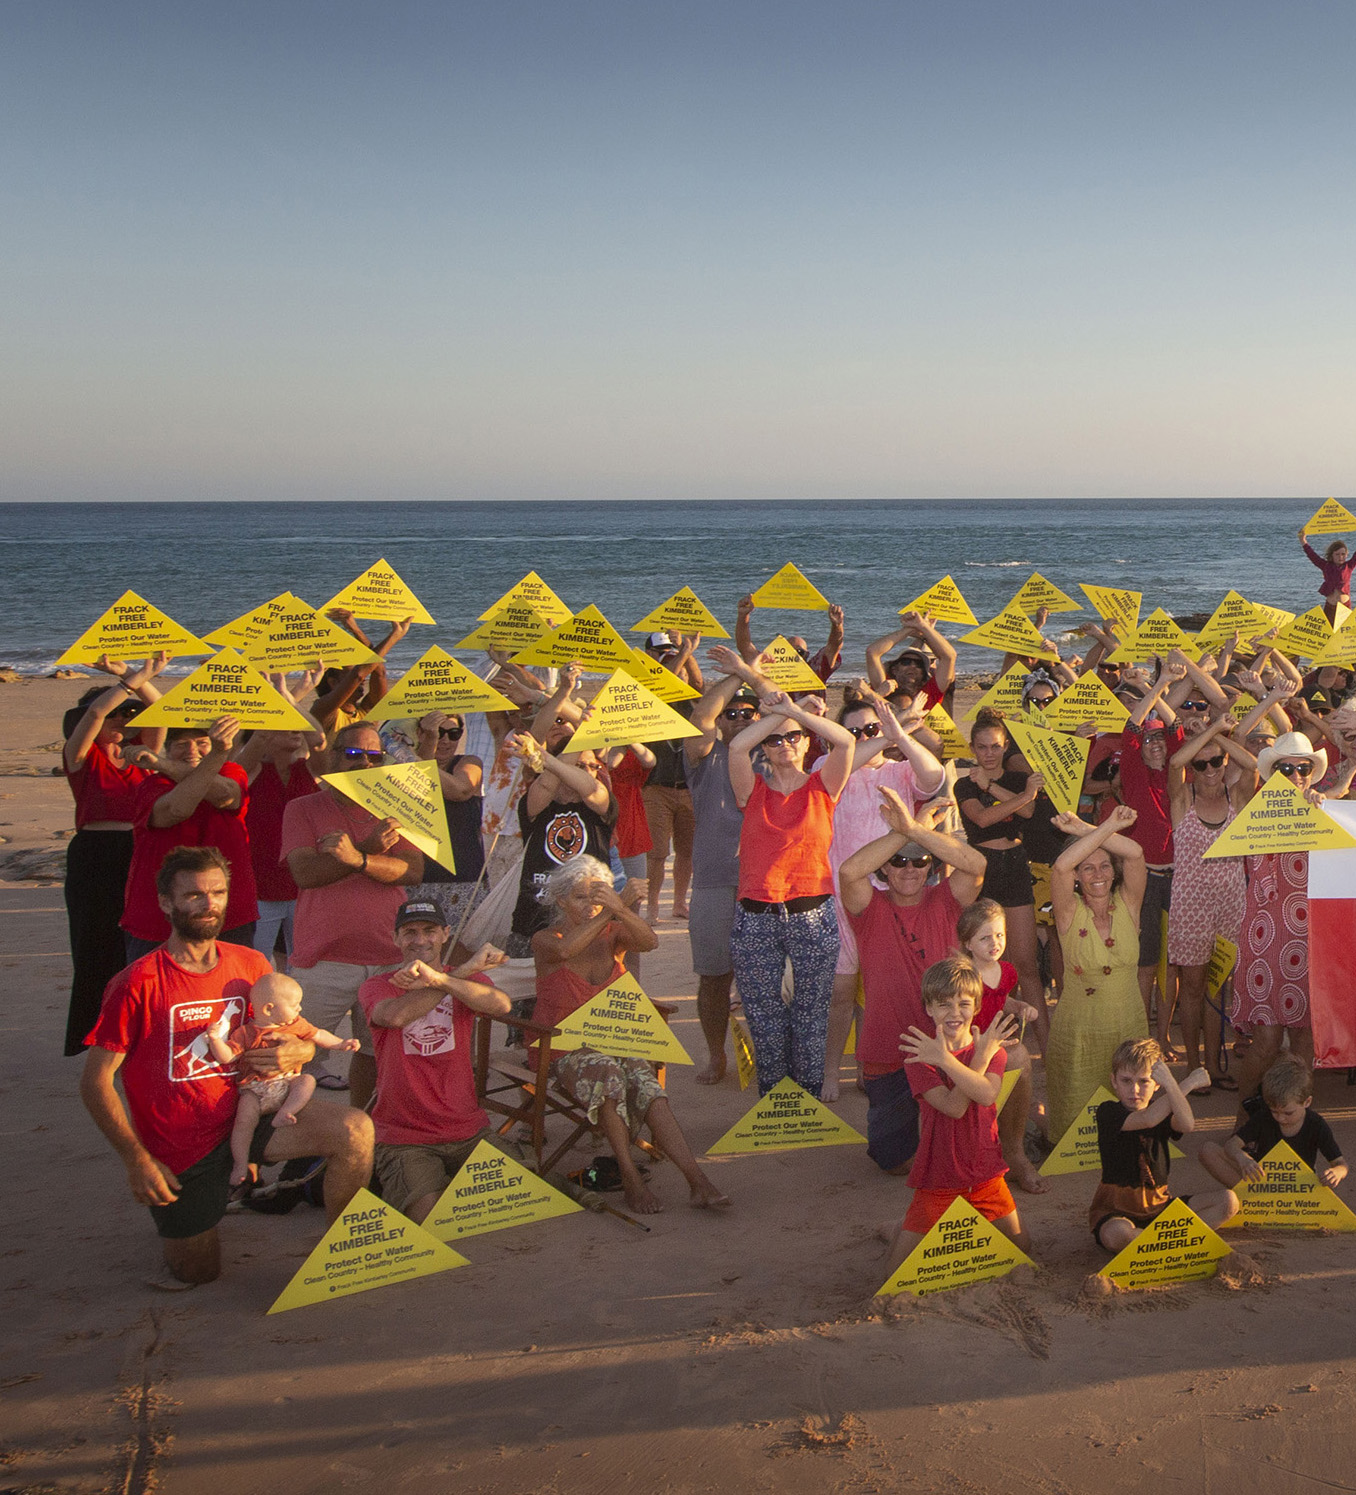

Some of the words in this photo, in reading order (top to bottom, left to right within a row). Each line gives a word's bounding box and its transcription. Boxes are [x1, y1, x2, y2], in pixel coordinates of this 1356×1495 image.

[113, 604, 149, 614] FRACK
[118, 613, 146, 622] FREE
[279, 612, 316, 623] FRACK
[572, 618, 605, 628] FRACK
[1003, 612, 1026, 622] FRACK
[102, 620, 163, 632] KIMBERLEY
[285, 621, 313, 631] FREE
[574, 626, 600, 636] FREE
[98, 635, 129, 643] Protect
[147, 632, 170, 640] Water
[268, 628, 331, 642] KIMBERLEY
[557, 633, 614, 646] KIMBERLEY
[206, 664, 248, 673] FRACK
[418, 659, 453, 669] FRACK
[210, 674, 242, 683] FREE
[423, 668, 450, 677] FREE
[408, 675, 467, 687] KIMBERLEY
[190, 683, 261, 694] KIMBERLEY
[608, 683, 639, 694] FRACK
[183, 697, 219, 706] Protect
[240, 699, 266, 707] Water
[613, 693, 638, 703] FREE
[1063, 697, 1110, 705] KIMBERLEY
[600, 700, 654, 714] KIMBERLEY
[1060, 743, 1077, 765] FREE
[1065, 736, 1085, 764] FRACK
[1046, 736, 1078, 782] KIMBERLEY
[405, 763, 439, 791] FRACK
[403, 774, 430, 796] FREE
[383, 771, 438, 815] KIMBERLEY
[1261, 788, 1296, 799] FRACK
[1266, 798, 1293, 808] FREE
[1250, 807, 1310, 820] KIMBERLEY
[1246, 823, 1276, 832] Protect
[1278, 822, 1293, 830] Our
[1294, 821, 1316, 829] Water
[1247, 832, 1272, 840] Country
[1276, 830, 1299, 838] Healthy
[1300, 828, 1333, 836] Community
[606, 989, 642, 1001] FRACK
[608, 999, 636, 1011] FREE
[180, 1006, 213, 1017] DINGO
[183, 1013, 211, 1022] FLOUR
[590, 1007, 651, 1023] KIMBERLEY
[769, 1091, 804, 1100] FRACK
[773, 1100, 800, 1109] FREE
[756, 1107, 817, 1119] KIMBERLEY
[752, 1123, 782, 1131] Protect
[785, 1121, 799, 1129] Our
[800, 1120, 822, 1128] Water
[465, 1156, 506, 1174] FRACK
[1262, 1161, 1301, 1170] FRACK
[472, 1168, 503, 1183] FREE
[1266, 1172, 1296, 1181] FREE
[455, 1175, 523, 1199] KIMBERLEY
[1247, 1183, 1314, 1193] KIMBERLEY
[452, 1199, 487, 1214] Protect
[488, 1195, 505, 1206] Our
[506, 1189, 531, 1202] Water
[342, 1205, 387, 1226] FRACK
[349, 1219, 383, 1237] FREE
[938, 1215, 978, 1233] FRACK
[1153, 1216, 1194, 1231] FRACK
[329, 1226, 405, 1255] KIMBERLEY
[942, 1228, 973, 1244] FREE
[1157, 1228, 1188, 1241] FREE
[923, 1235, 991, 1260] KIMBERLEY
[1136, 1235, 1205, 1254] KIMBERLEY
[325, 1254, 363, 1272] Protect
[366, 1249, 384, 1262] Our
[386, 1242, 413, 1257] Water
[917, 1261, 952, 1276] Protect
[954, 1257, 970, 1268] Our
[971, 1251, 996, 1264] Water
